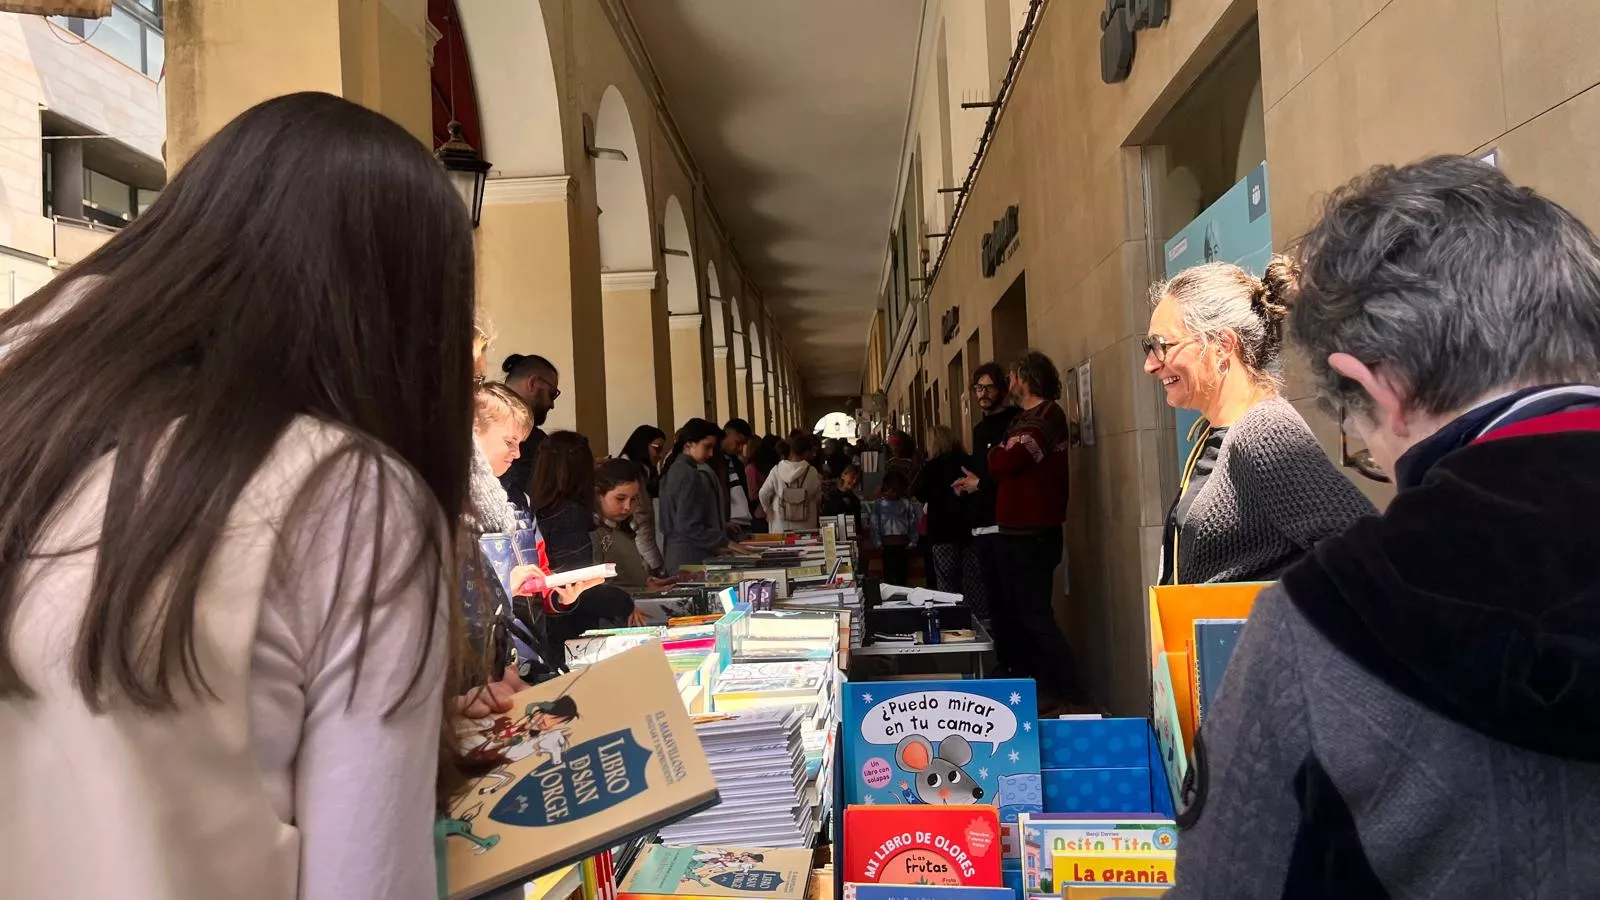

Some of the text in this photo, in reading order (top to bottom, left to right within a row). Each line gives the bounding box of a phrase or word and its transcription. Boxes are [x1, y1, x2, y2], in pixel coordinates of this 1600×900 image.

[882, 694, 995, 721] ¿Puedo mirar
[885, 715, 994, 737] en tu cama?
[597, 737, 630, 794] LIBRO
[863, 769, 878, 777] libro
[867, 774, 890, 783] solapas
[530, 762, 569, 823] JORGE
[864, 858, 880, 878] MI
[874, 832, 912, 860] LIBRO
[915, 831, 932, 844] DE
[934, 835, 976, 878] OLORES
[905, 857, 948, 874] frutas
[1073, 863, 1096, 881] La
